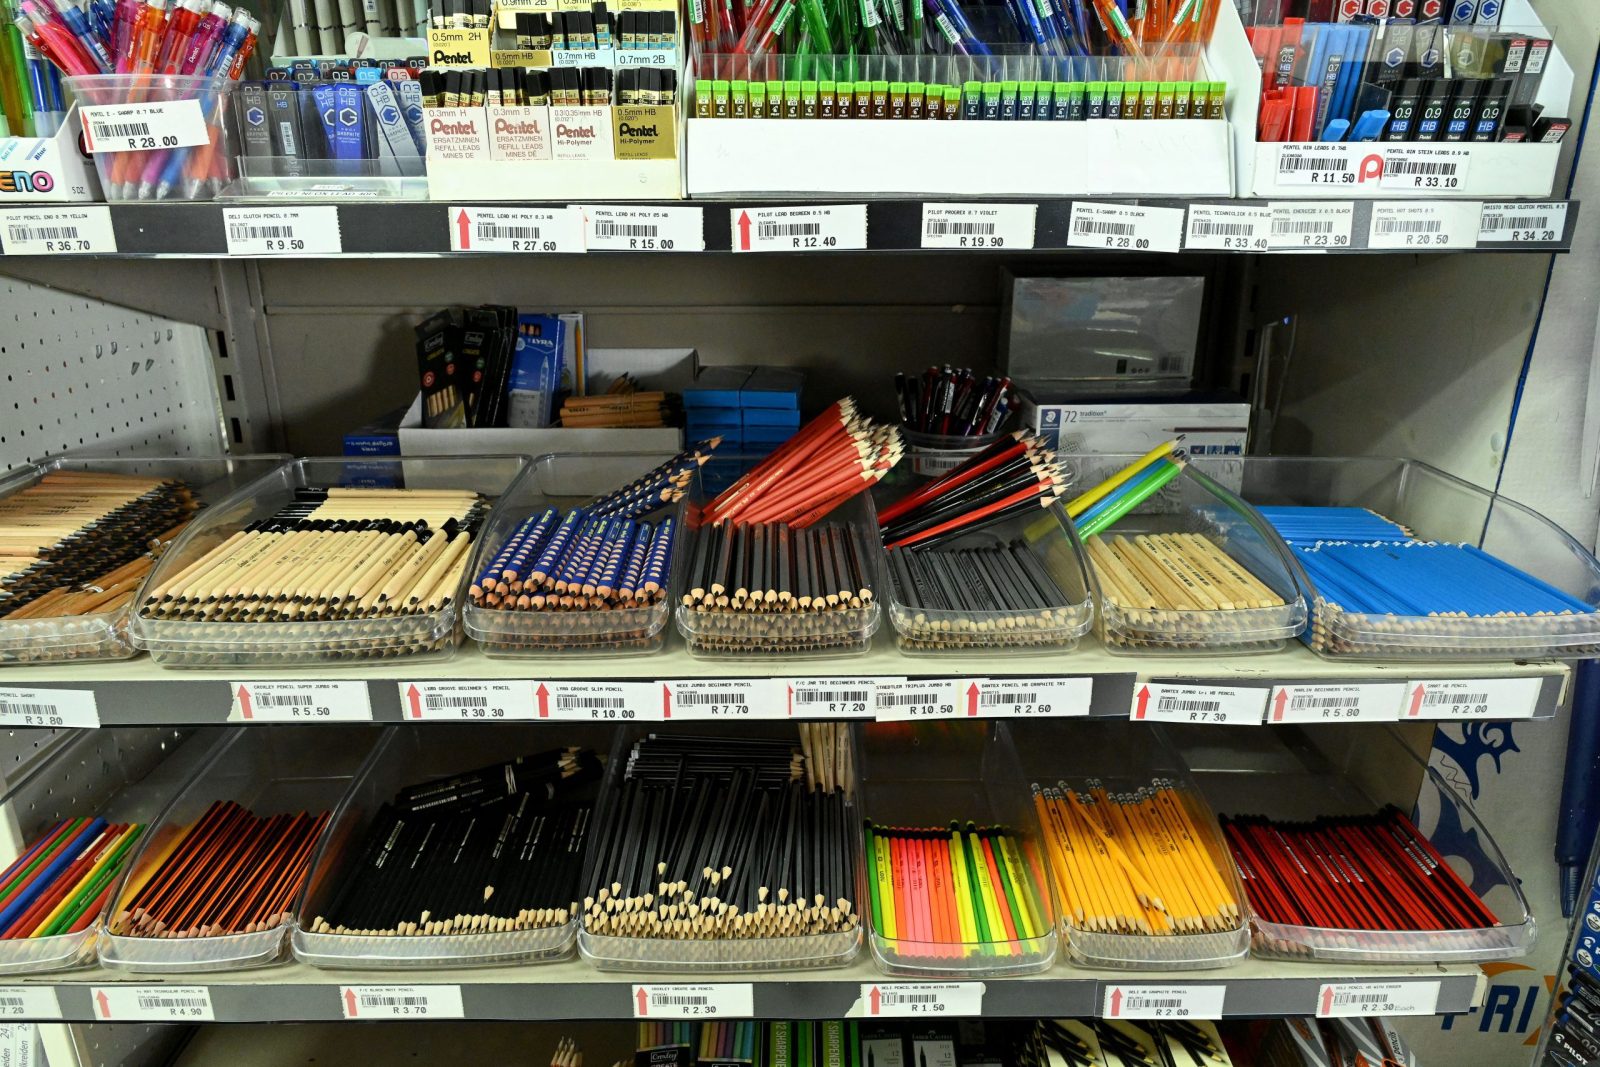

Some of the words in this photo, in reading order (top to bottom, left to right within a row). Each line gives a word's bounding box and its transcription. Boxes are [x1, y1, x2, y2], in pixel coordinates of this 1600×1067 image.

[432, 32, 462, 41] 0.5mm
[469, 32, 482, 41] 2H
[434, 51, 474, 64] Pentel
[558, 52, 582, 60] 0.7mm
[583, 52, 596, 60] HB
[620, 55, 651, 64] 0.7mm
[653, 55, 666, 64] 2B
[1282, 54, 1294, 63] 0.5
[340, 97, 356, 106] HB
[375, 97, 390, 105] HB
[428, 109, 456, 117] 0.3mm
[460, 109, 467, 117] H
[493, 108, 520, 116] 0.3mm
[617, 108, 643, 116] 0.5mm
[644, 108, 657, 116] HB
[1395, 108, 1412, 119] 0.9
[1425, 108, 1441, 119] 0.9
[1453, 108, 1470, 119] 0.9
[1482, 108, 1499, 119] 0.9
[431, 119, 477, 135] Pentel
[495, 118, 541, 135] Pentel
[620, 123, 659, 137] Pentel
[1392, 121, 1407, 130] HB
[1421, 121, 1437, 130] HB
[1450, 121, 1465, 130] HB
[1479, 121, 1494, 130] HB
[556, 124, 595, 139] Pentel
[128, 138, 136, 149] R
[140, 135, 178, 148] 28.00
[433, 137, 480, 145] ERSATZMINEN
[496, 136, 544, 144] ERSATZMINEN
[558, 139, 593, 147] Hi-Polymer
[620, 138, 655, 146] Hi-Polymer
[435, 144, 457, 152] REFILL
[498, 143, 520, 151] REFILL
[521, 143, 544, 151] LEADS
[34, 147, 46, 161] Blue
[1311, 173, 1319, 183] R
[1323, 172, 1355, 183] 11.50
[1414, 176, 1422, 187] R
[1426, 177, 1457, 188] 33.10
[1303, 235, 1310, 245] R
[1314, 234, 1347, 245] 23.90
[1406, 234, 1414, 245] R
[1417, 234, 1449, 245] 20.50
[1512, 232, 1520, 241] R
[1523, 230, 1555, 241] 34.20
[47, 241, 54, 251] R
[58, 240, 91, 251] 36.70
[267, 240, 274, 250] R
[278, 240, 304, 250] 9.50
[512, 241, 519, 251] R
[524, 241, 557, 251] 27.60
[630, 239, 637, 249] R
[641, 239, 674, 249] 15.00
[793, 238, 800, 248] R
[804, 237, 836, 247] 12.40
[960, 237, 967, 247] R
[972, 237, 1004, 247] 19.90
[1106, 236, 1113, 247] R
[1117, 237, 1149, 249] 28.00
[1224, 237, 1231, 248] R
[1235, 238, 1267, 249] 33.40
[531, 338, 553, 346] LYRA
[1064, 410, 1077, 423] 72
[293, 707, 300, 715] R
[304, 707, 330, 715] 5.50
[711, 706, 718, 714] R
[723, 705, 749, 714] 7.70
[840, 703, 866, 712] 7.20
[910, 706, 917, 714] R
[921, 705, 953, 713] 10.50
[1014, 705, 1021, 714] R
[1025, 705, 1051, 713] 2.60
[1452, 705, 1459, 714] R
[1463, 705, 1488, 713] 2.00
[461, 709, 468, 717] R
[472, 709, 504, 717] 30.30
[592, 710, 598, 718] R
[603, 710, 635, 718] 10.00
[1190, 712, 1197, 720] R
[1323, 709, 1330, 717] R
[1334, 709, 1360, 717] 5.80
[25, 716, 32, 724] R
[36, 716, 63, 725] 3.80
[170, 1008, 176, 1016] R
[179, 1008, 202, 1016] 4.90
[683, 1006, 689, 1014] R
[693, 1006, 717, 1014] 2.30
[922, 1004, 945, 1012] 1.50
[1563, 1041, 1588, 1066] PILOT
